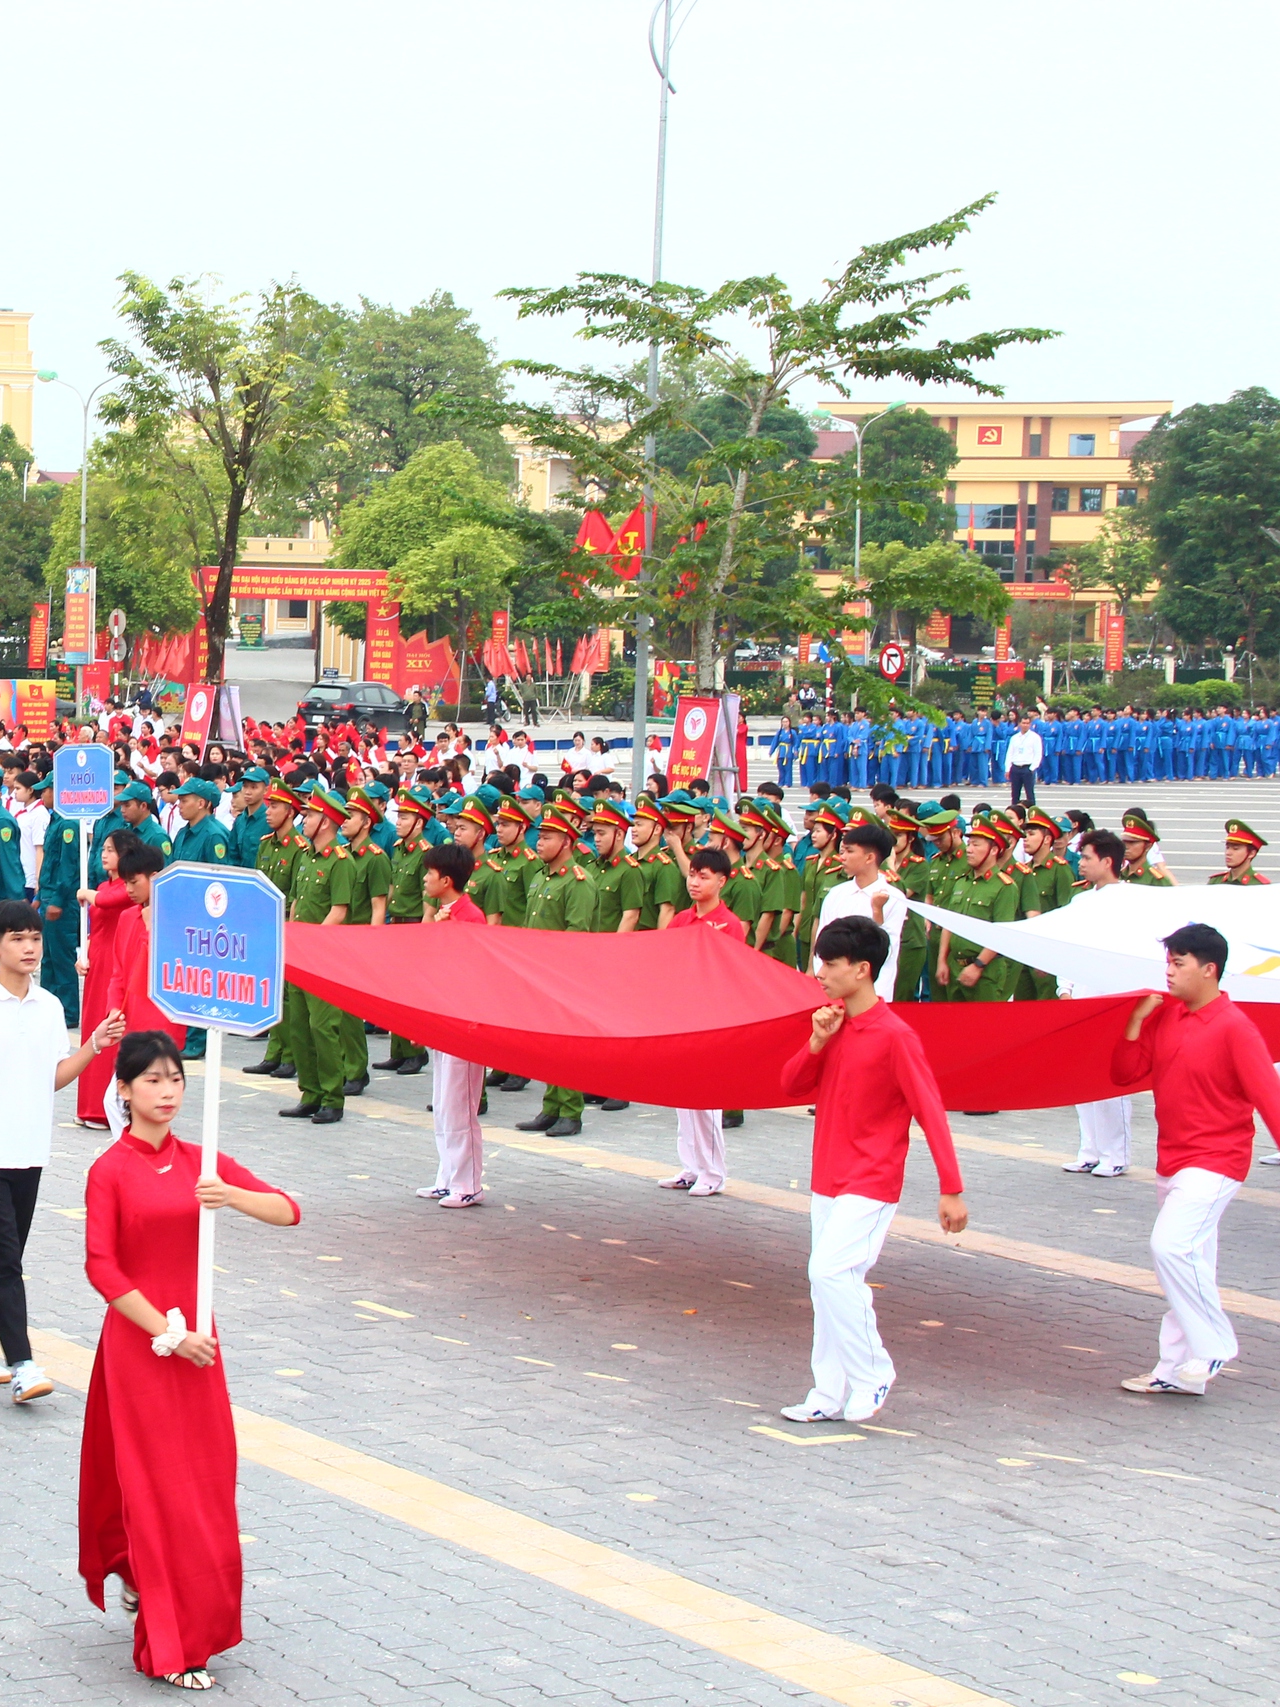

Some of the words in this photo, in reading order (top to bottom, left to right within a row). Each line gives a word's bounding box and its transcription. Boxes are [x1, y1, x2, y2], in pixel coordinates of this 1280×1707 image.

[241, 575, 250, 583] ĐẠI
[251, 575, 261, 584] HỘI
[261, 576, 271, 585] ĐẠI
[271, 574, 283, 584] BIỂU
[284, 575, 299, 584] ĐẢNG
[300, 576, 307, 586] BỘ
[308, 576, 319, 585] CÁC
[320, 576, 331, 585] CẤP
[332, 577, 349, 586] NHIỆM
[239, 584, 251, 594] BIỂU
[252, 586, 266, 594] TOÀN
[266, 586, 281, 595] QUỐC
[282, 586, 292, 595] LẦN
[314, 587, 324, 596] CỦA
[325, 587, 340, 596] ĐẢNG
[341, 588, 355, 597] CỘNG
[405, 659, 432, 668] XIV
[70, 767, 95, 785] KHỐI
[60, 788, 73, 805] CÔNG
[73, 791, 81, 805] AN
[81, 788, 95, 805] NHÂN
[96, 787, 108, 805] DÂN
[185, 924, 247, 962] THÔN
[162, 958, 213, 998] LÀNG
[216, 969, 257, 1005] KIM
[260, 977, 271, 1007] 1
